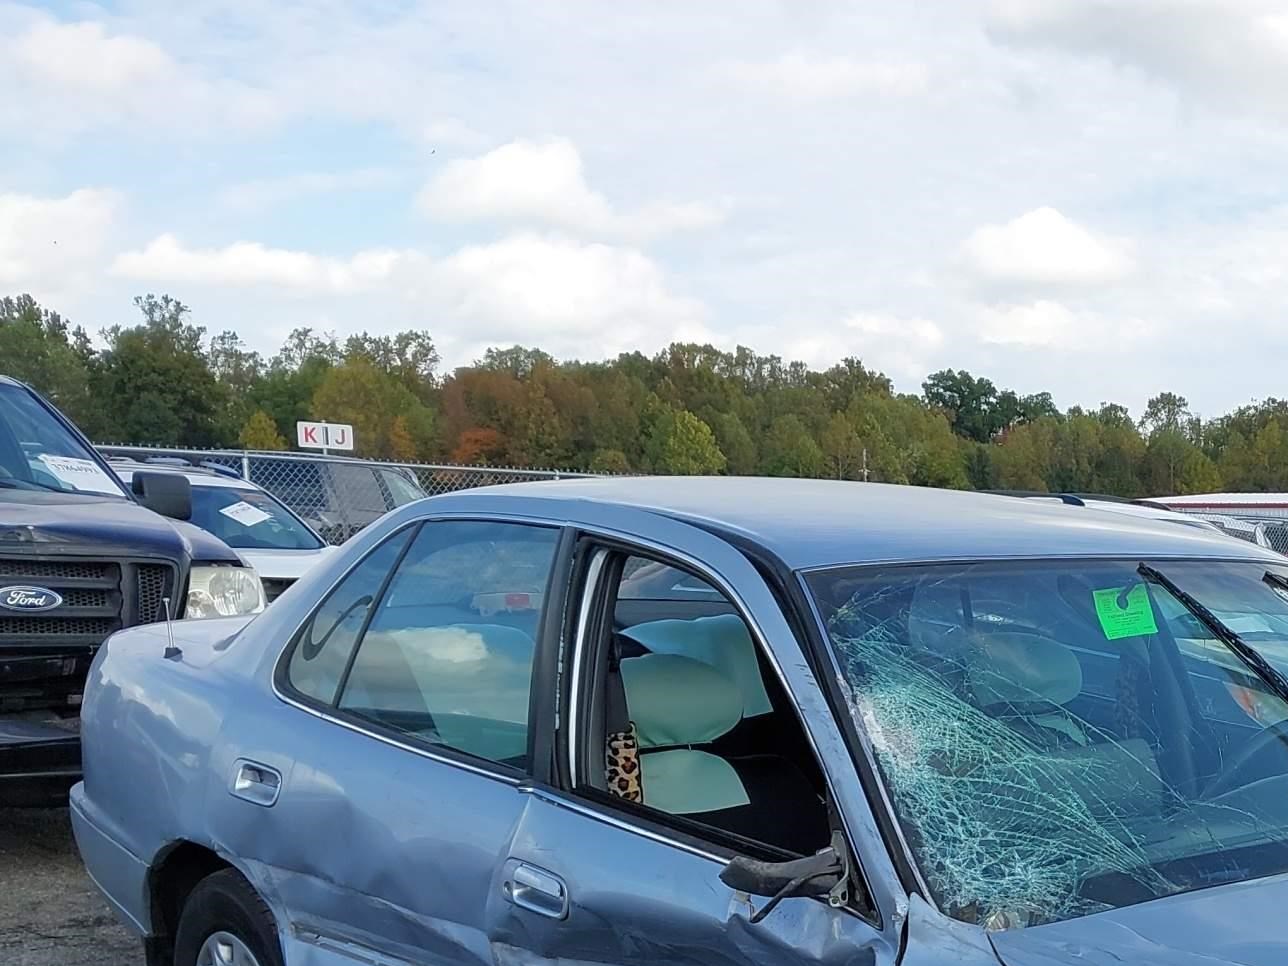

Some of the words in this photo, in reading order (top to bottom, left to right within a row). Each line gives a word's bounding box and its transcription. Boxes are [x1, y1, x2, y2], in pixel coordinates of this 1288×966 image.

[304, 426, 318, 443] K
[335, 429, 346, 445] J
[6, 590, 46, 606] Ford
